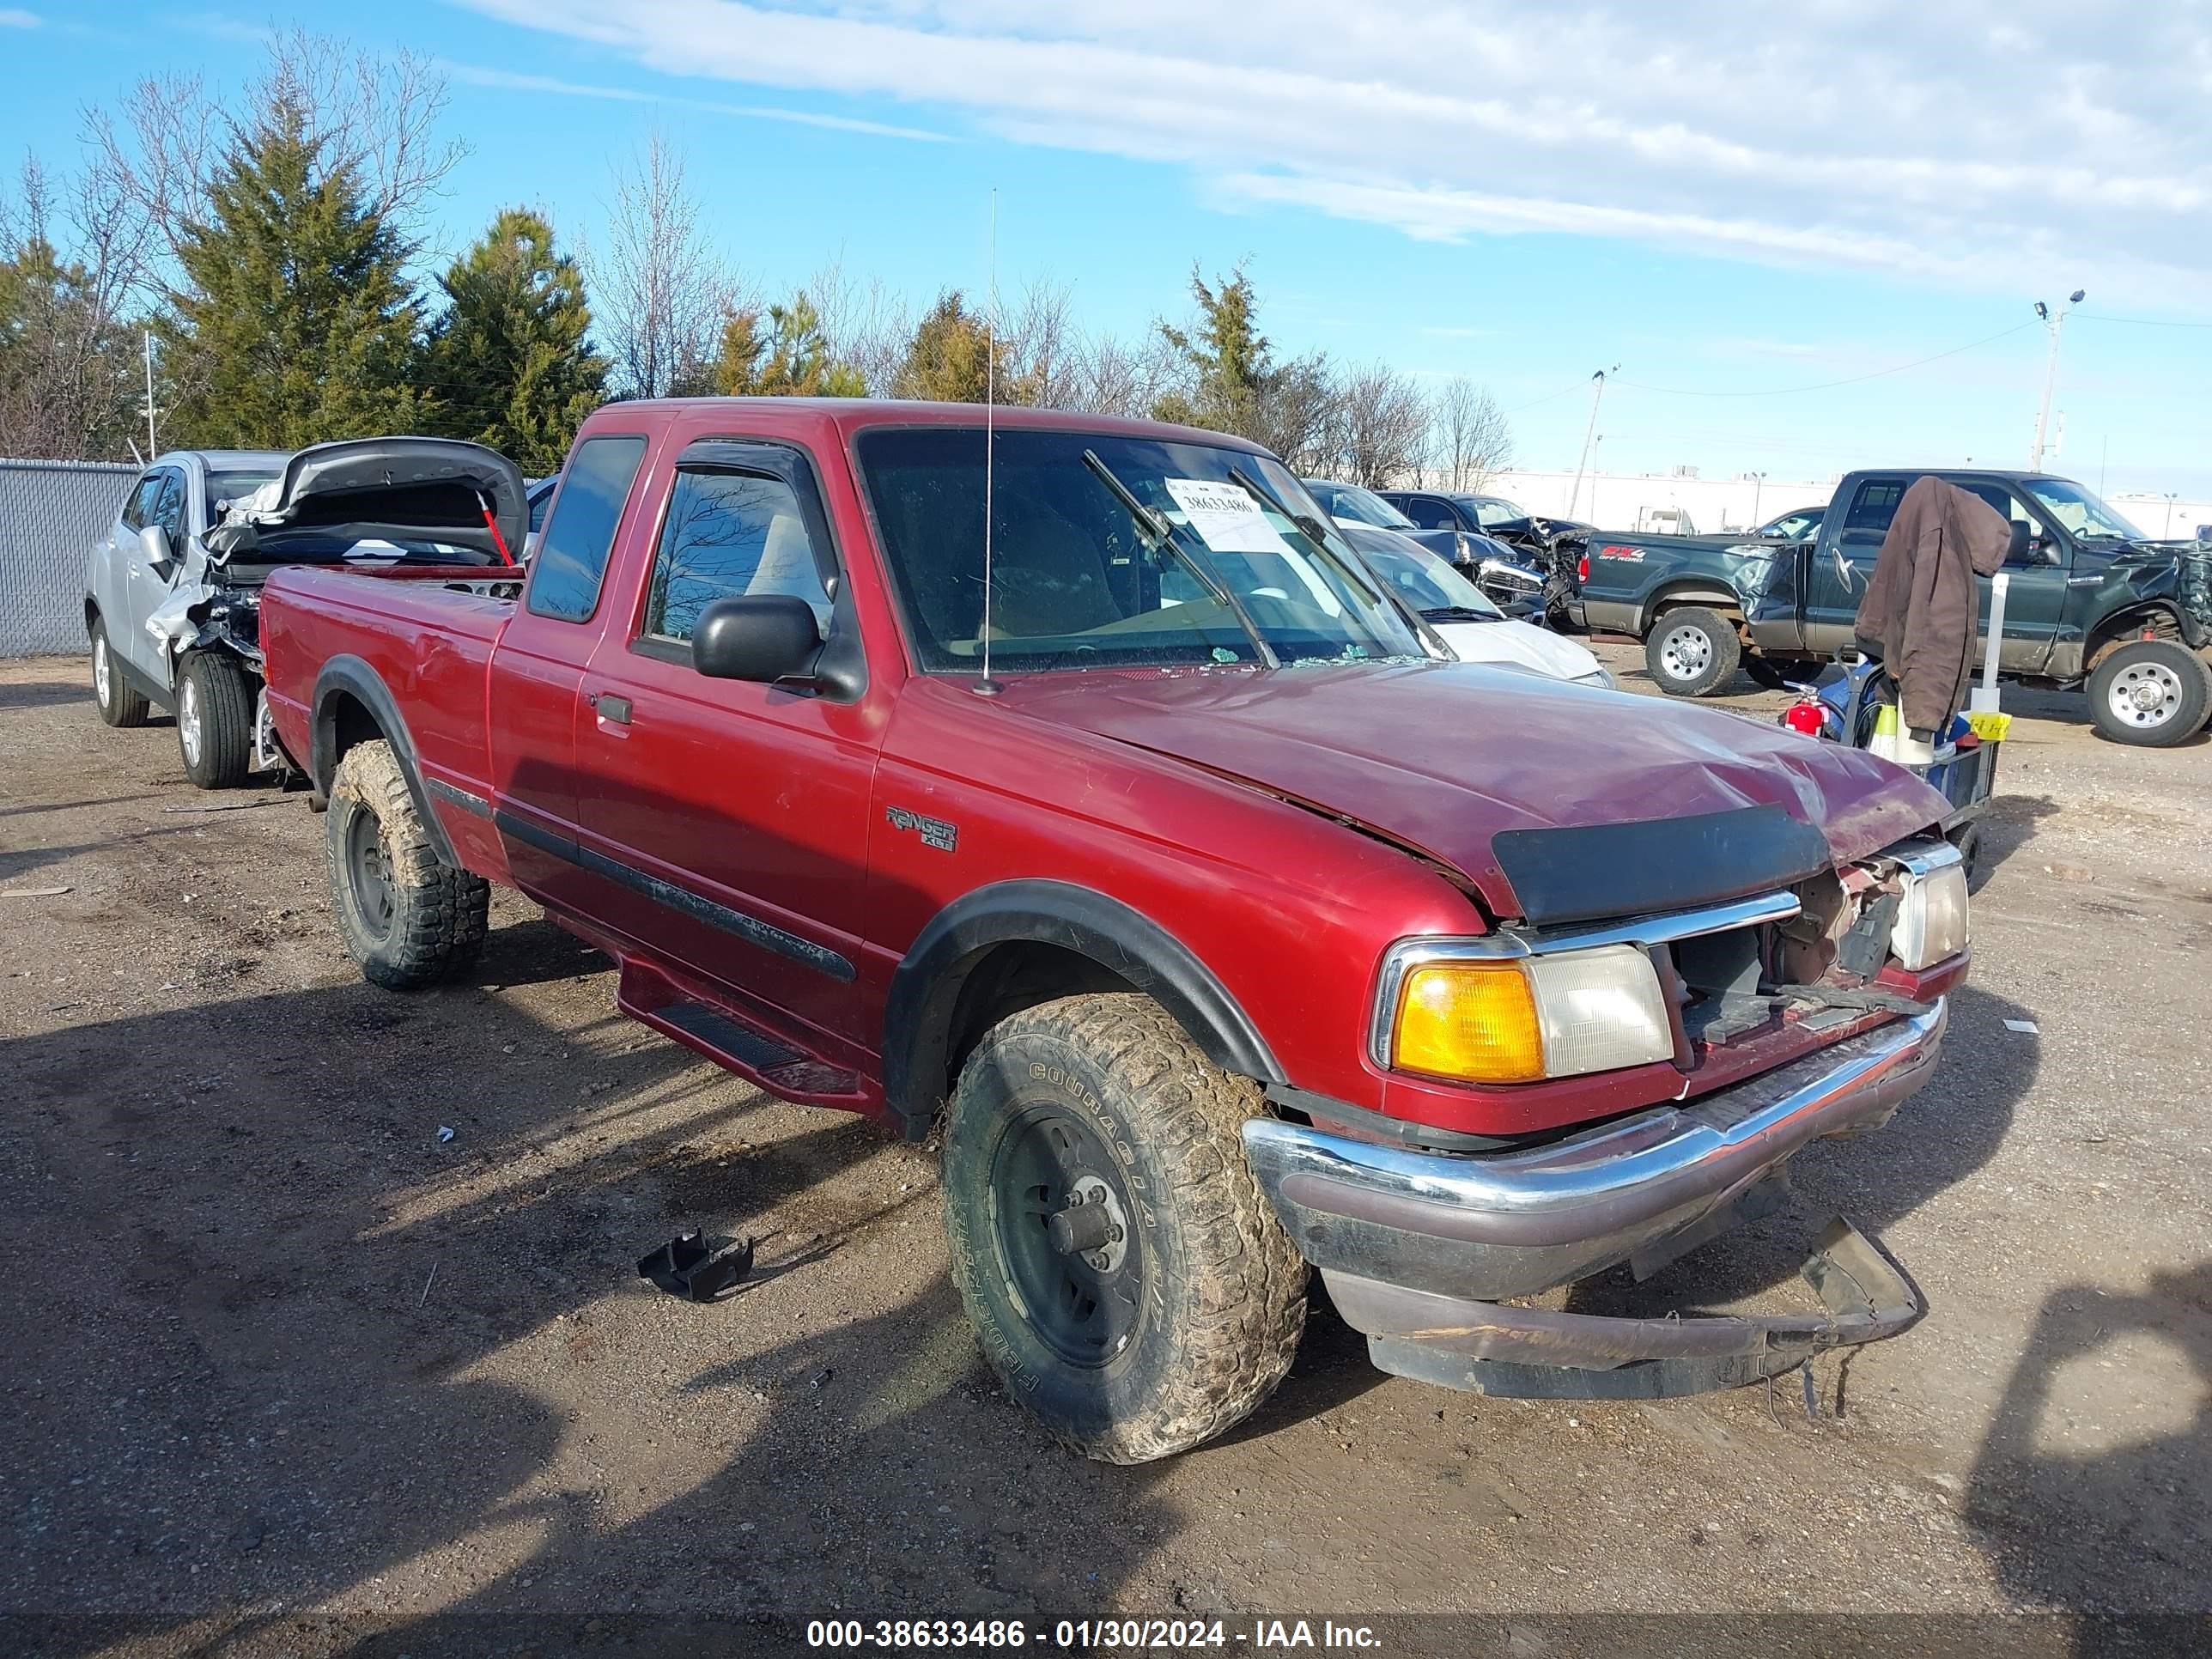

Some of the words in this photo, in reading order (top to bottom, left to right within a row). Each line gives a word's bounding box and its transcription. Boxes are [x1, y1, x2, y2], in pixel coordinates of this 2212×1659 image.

[1183, 495, 1253, 514] 38633486
[886, 805, 957, 842] RANGER
[922, 834, 955, 852] XLT
